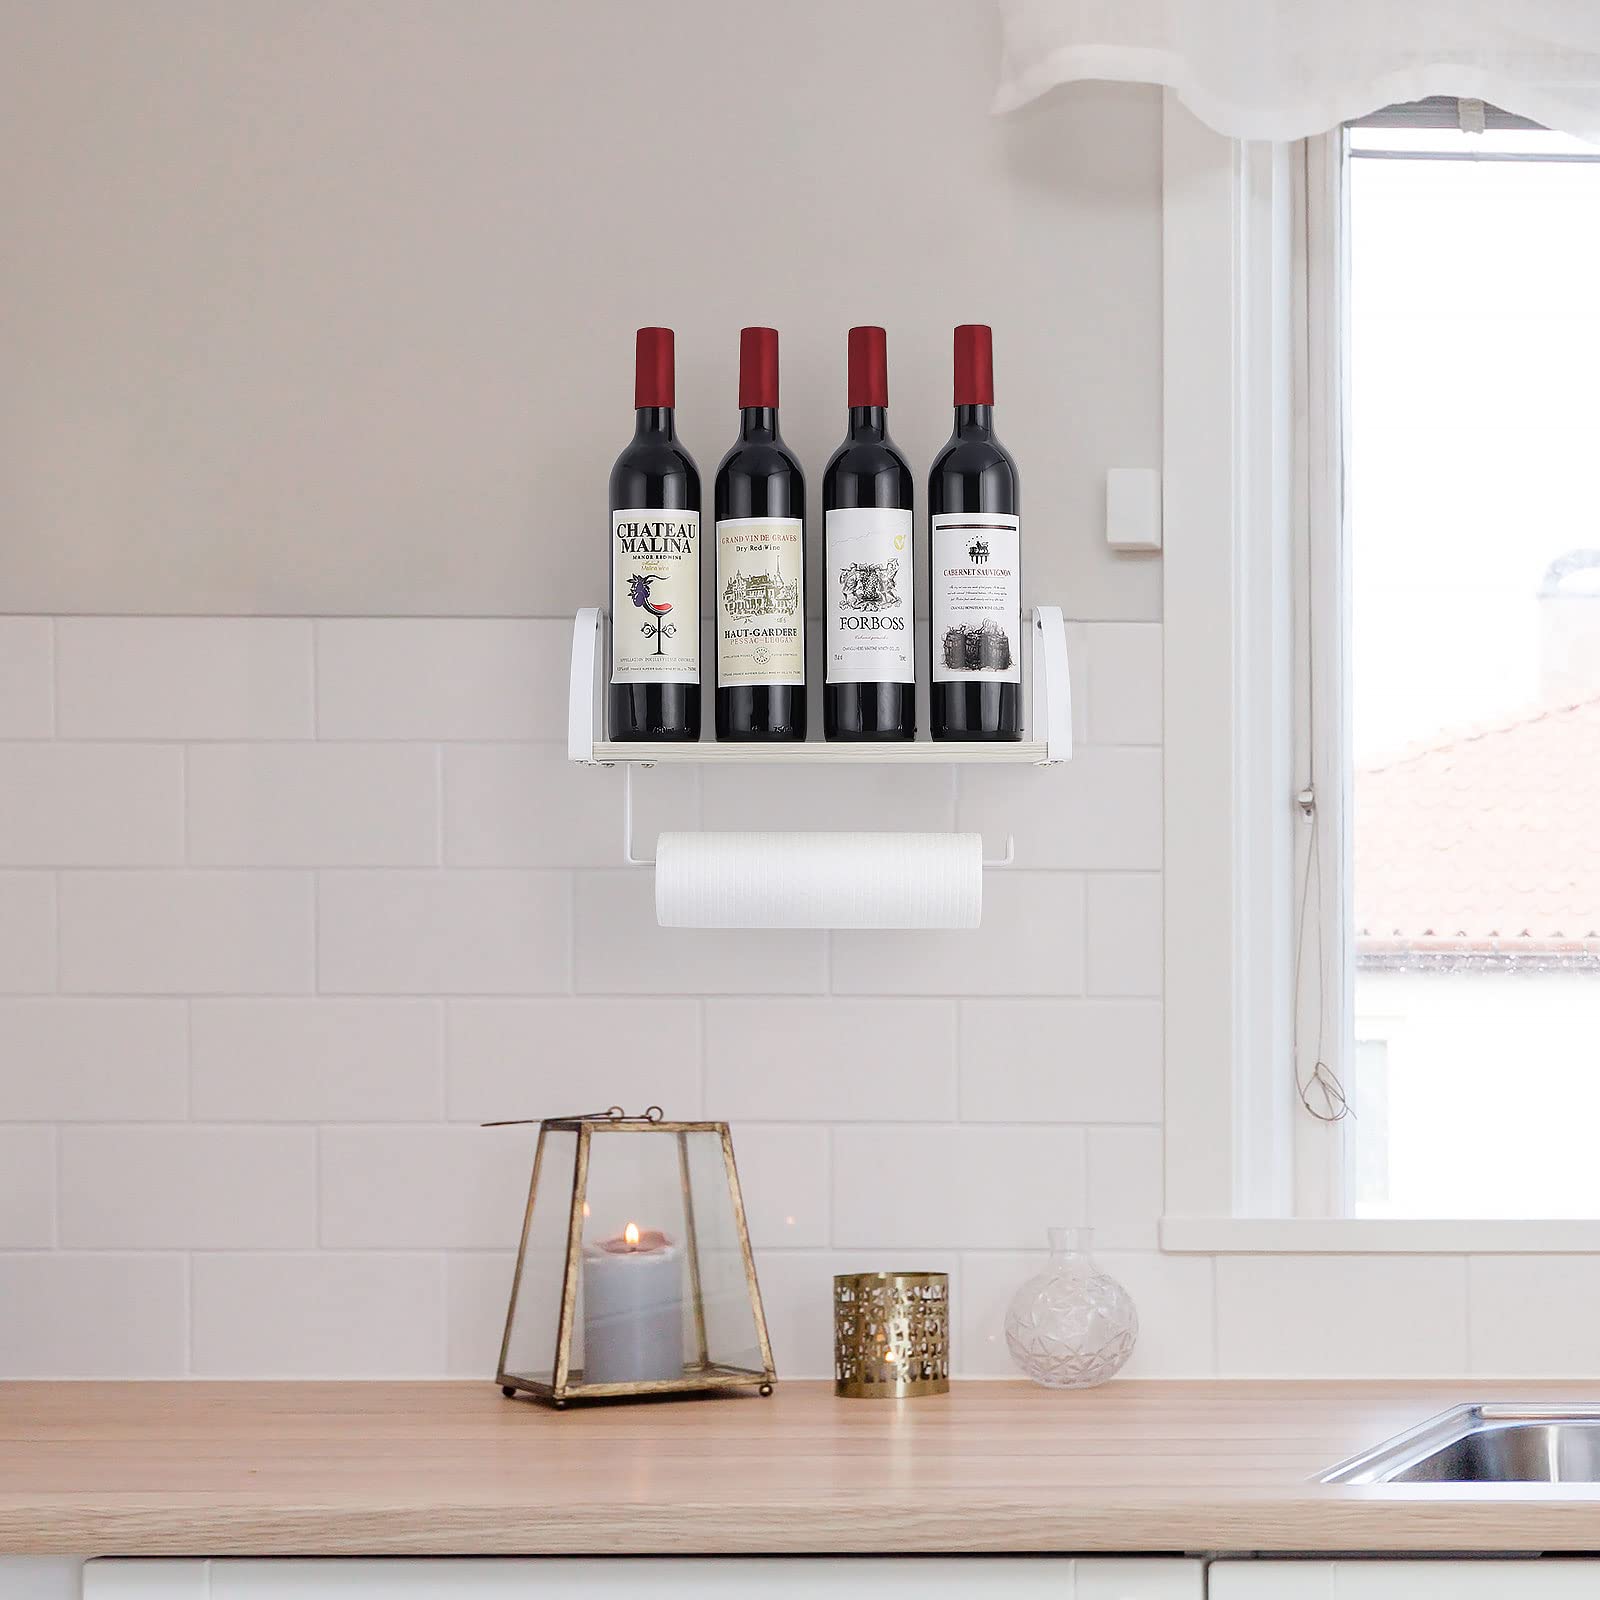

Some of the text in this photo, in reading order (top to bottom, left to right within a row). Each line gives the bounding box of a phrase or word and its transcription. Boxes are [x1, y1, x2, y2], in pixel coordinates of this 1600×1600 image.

[617, 522, 696, 538] CHATEAU
[621, 537, 692, 553] MALINA
[721, 534, 797, 545] GRAND VIN DE GRAVES
[764, 543, 780, 551] Wine
[943, 568, 1011, 577] CABERNET SAUVIGNON
[840, 616, 905, 630] FORBOSS
